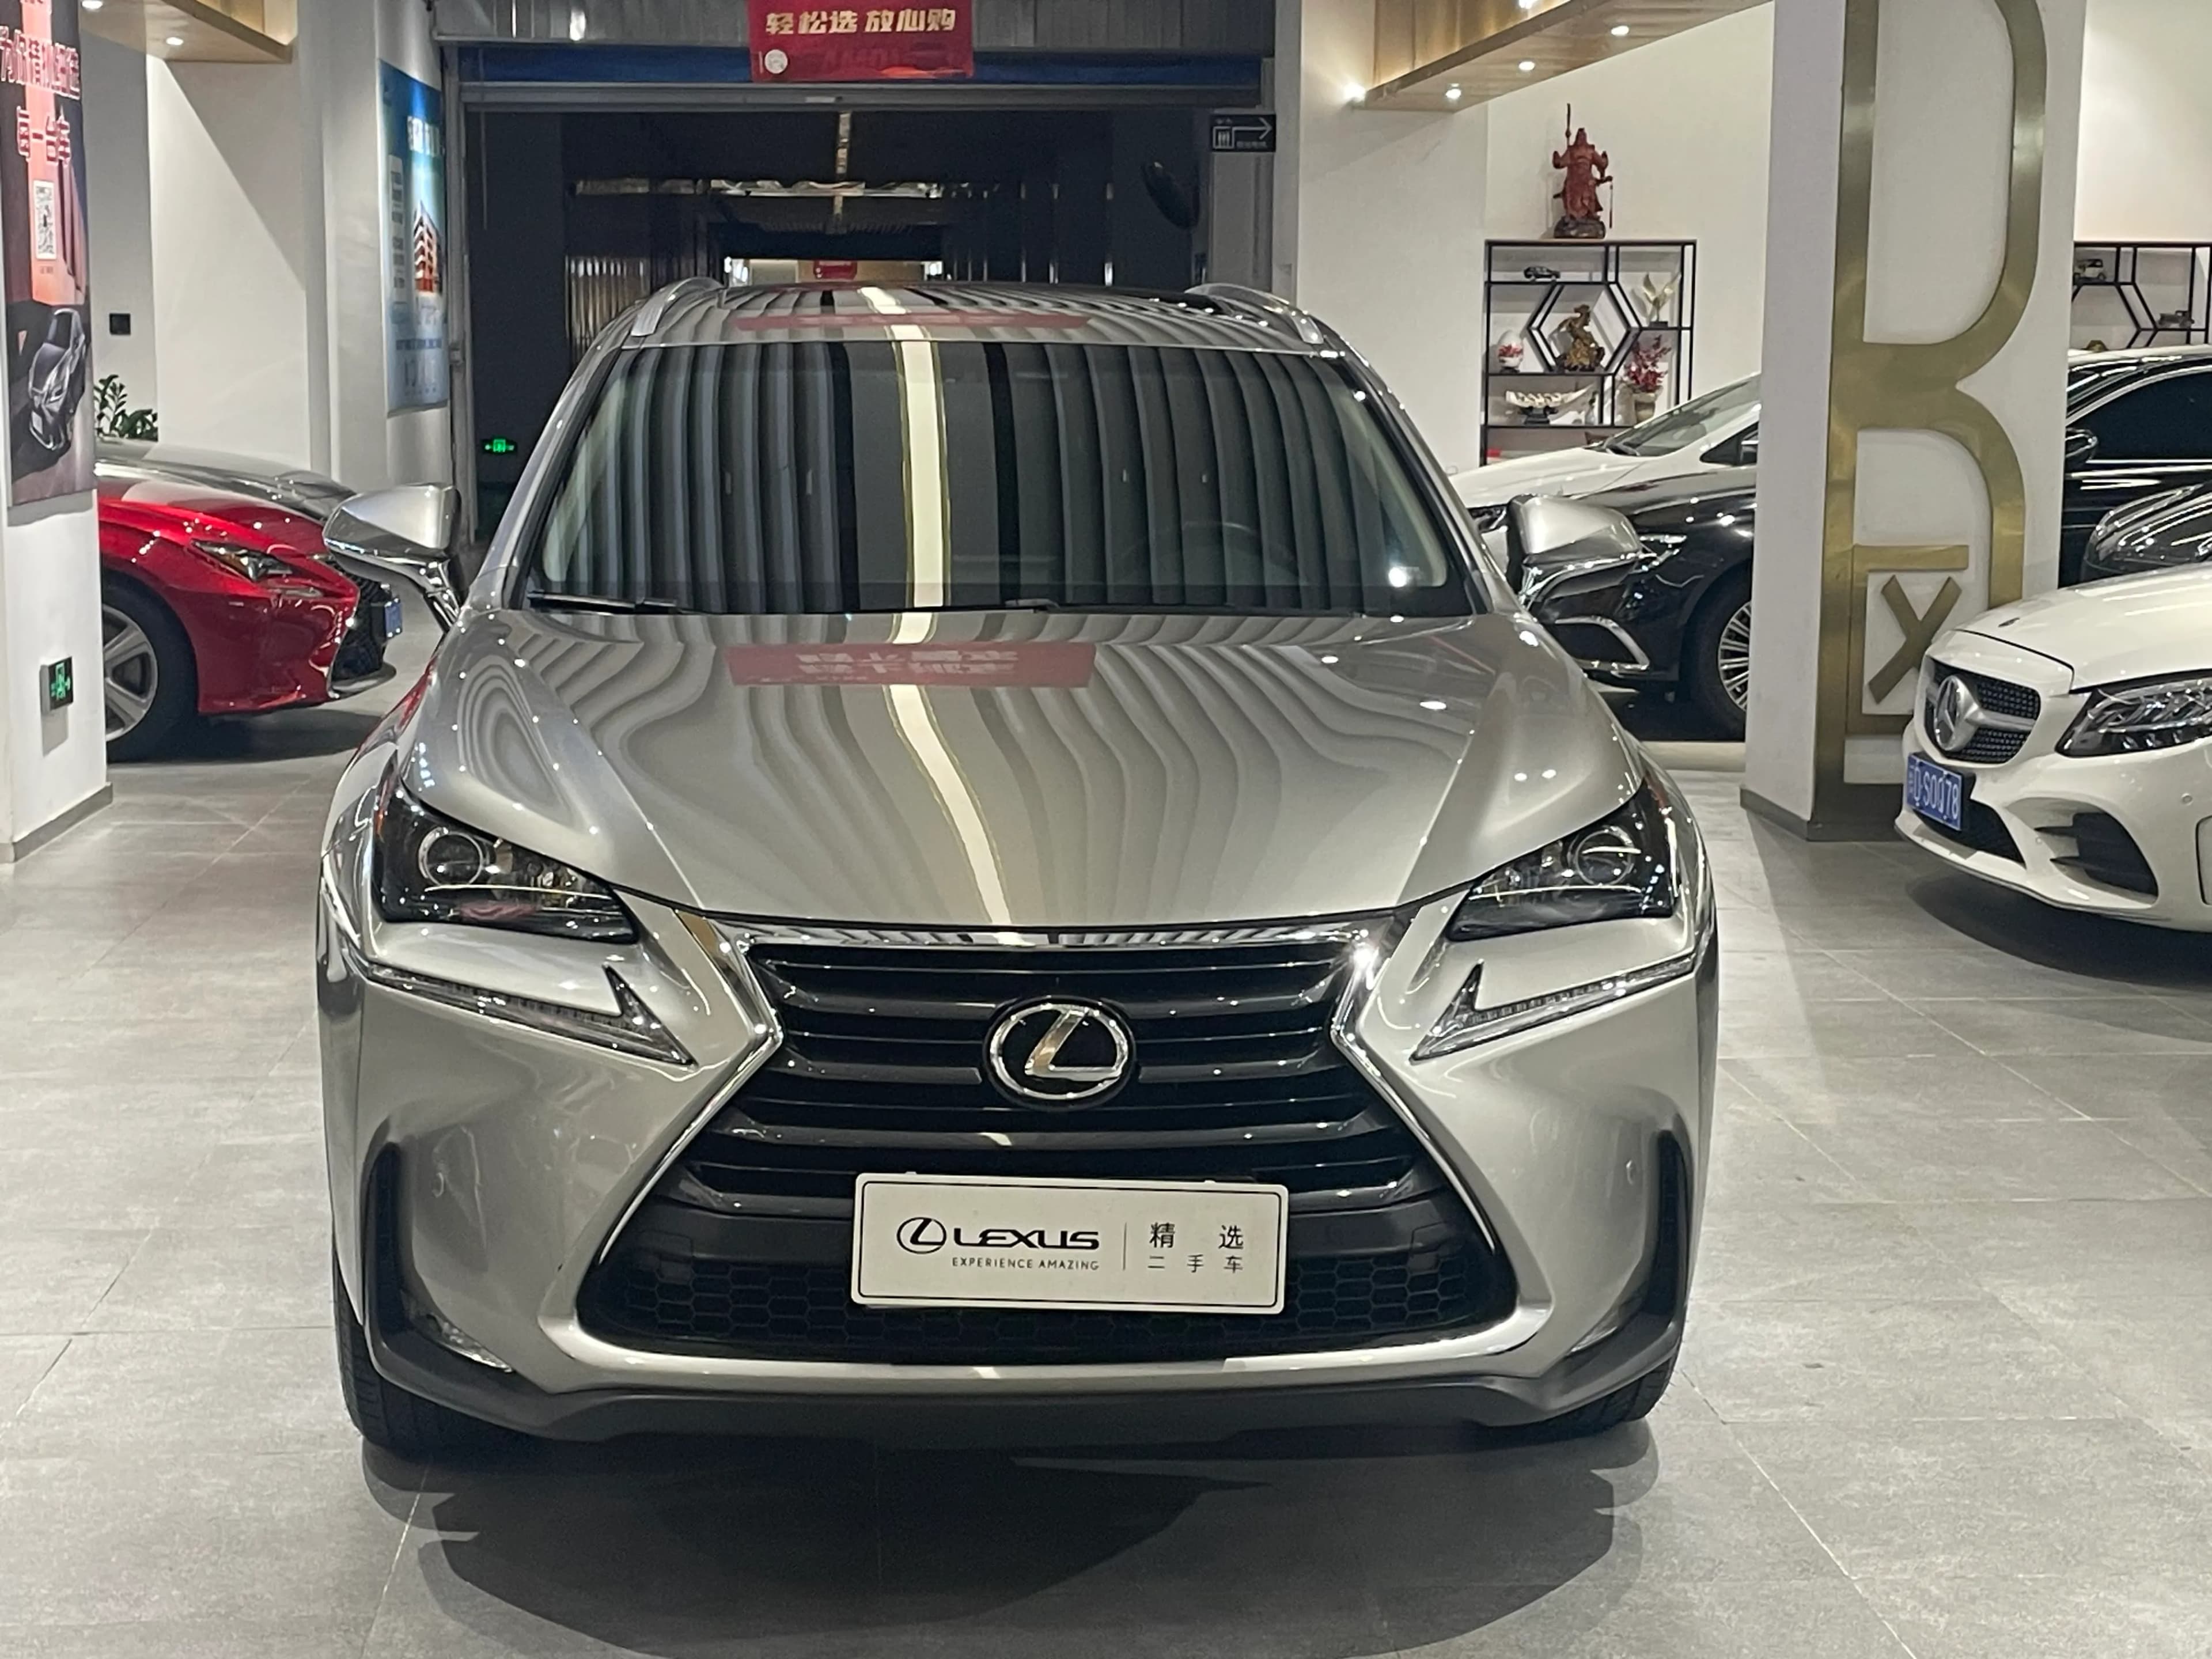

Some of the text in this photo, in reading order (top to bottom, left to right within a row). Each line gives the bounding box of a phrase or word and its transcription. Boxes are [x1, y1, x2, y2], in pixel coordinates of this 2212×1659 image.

[766, 8, 956, 35] 轻松选 放心购
[953, 1228, 1100, 1250] LEXUS
[952, 1257, 1100, 1271] EXPERIENCE AMAZING
[1147, 1253, 1244, 1274] 二手车
